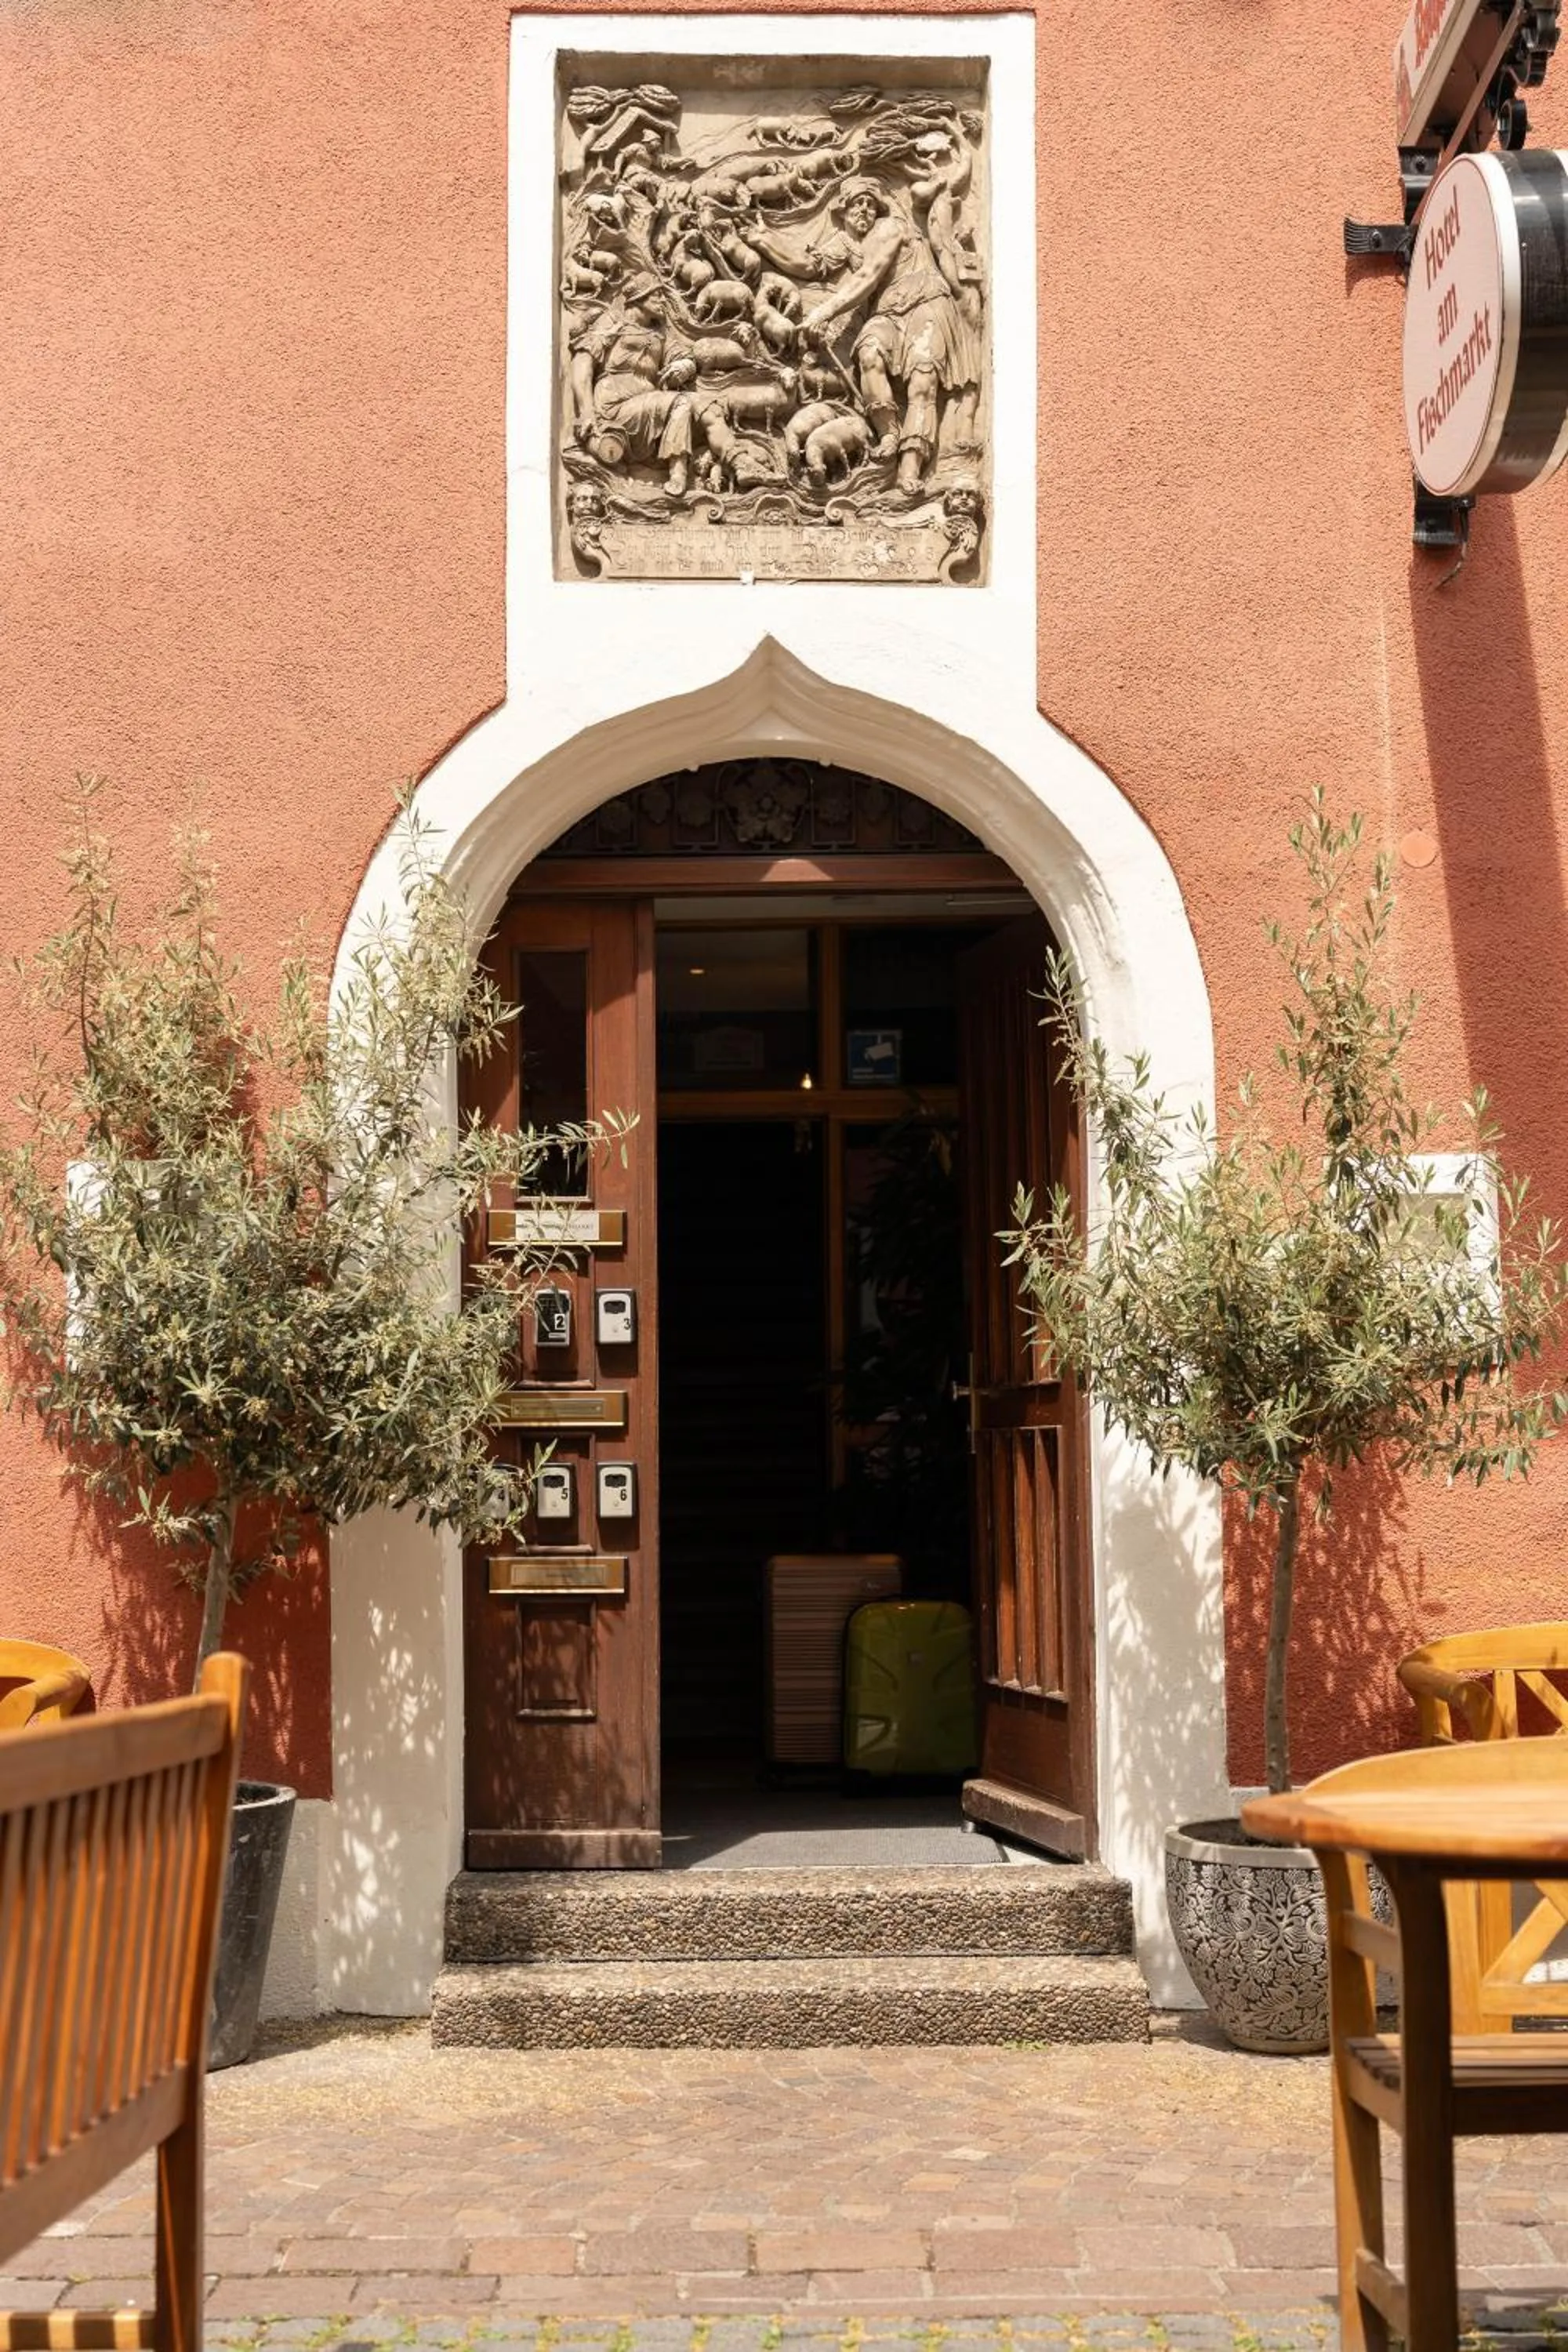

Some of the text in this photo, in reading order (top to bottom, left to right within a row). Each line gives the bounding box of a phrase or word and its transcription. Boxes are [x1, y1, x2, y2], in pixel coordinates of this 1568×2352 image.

[1425, 184, 1461, 290] Hotel
[1438, 283, 1459, 346] am
[1417, 299, 1492, 456] Fischmarkt
[556, 1316, 564, 1328] 2
[623, 1318, 631, 1330] 3
[561, 1488, 568, 1500] 5
[620, 1489, 628, 1501] 6
